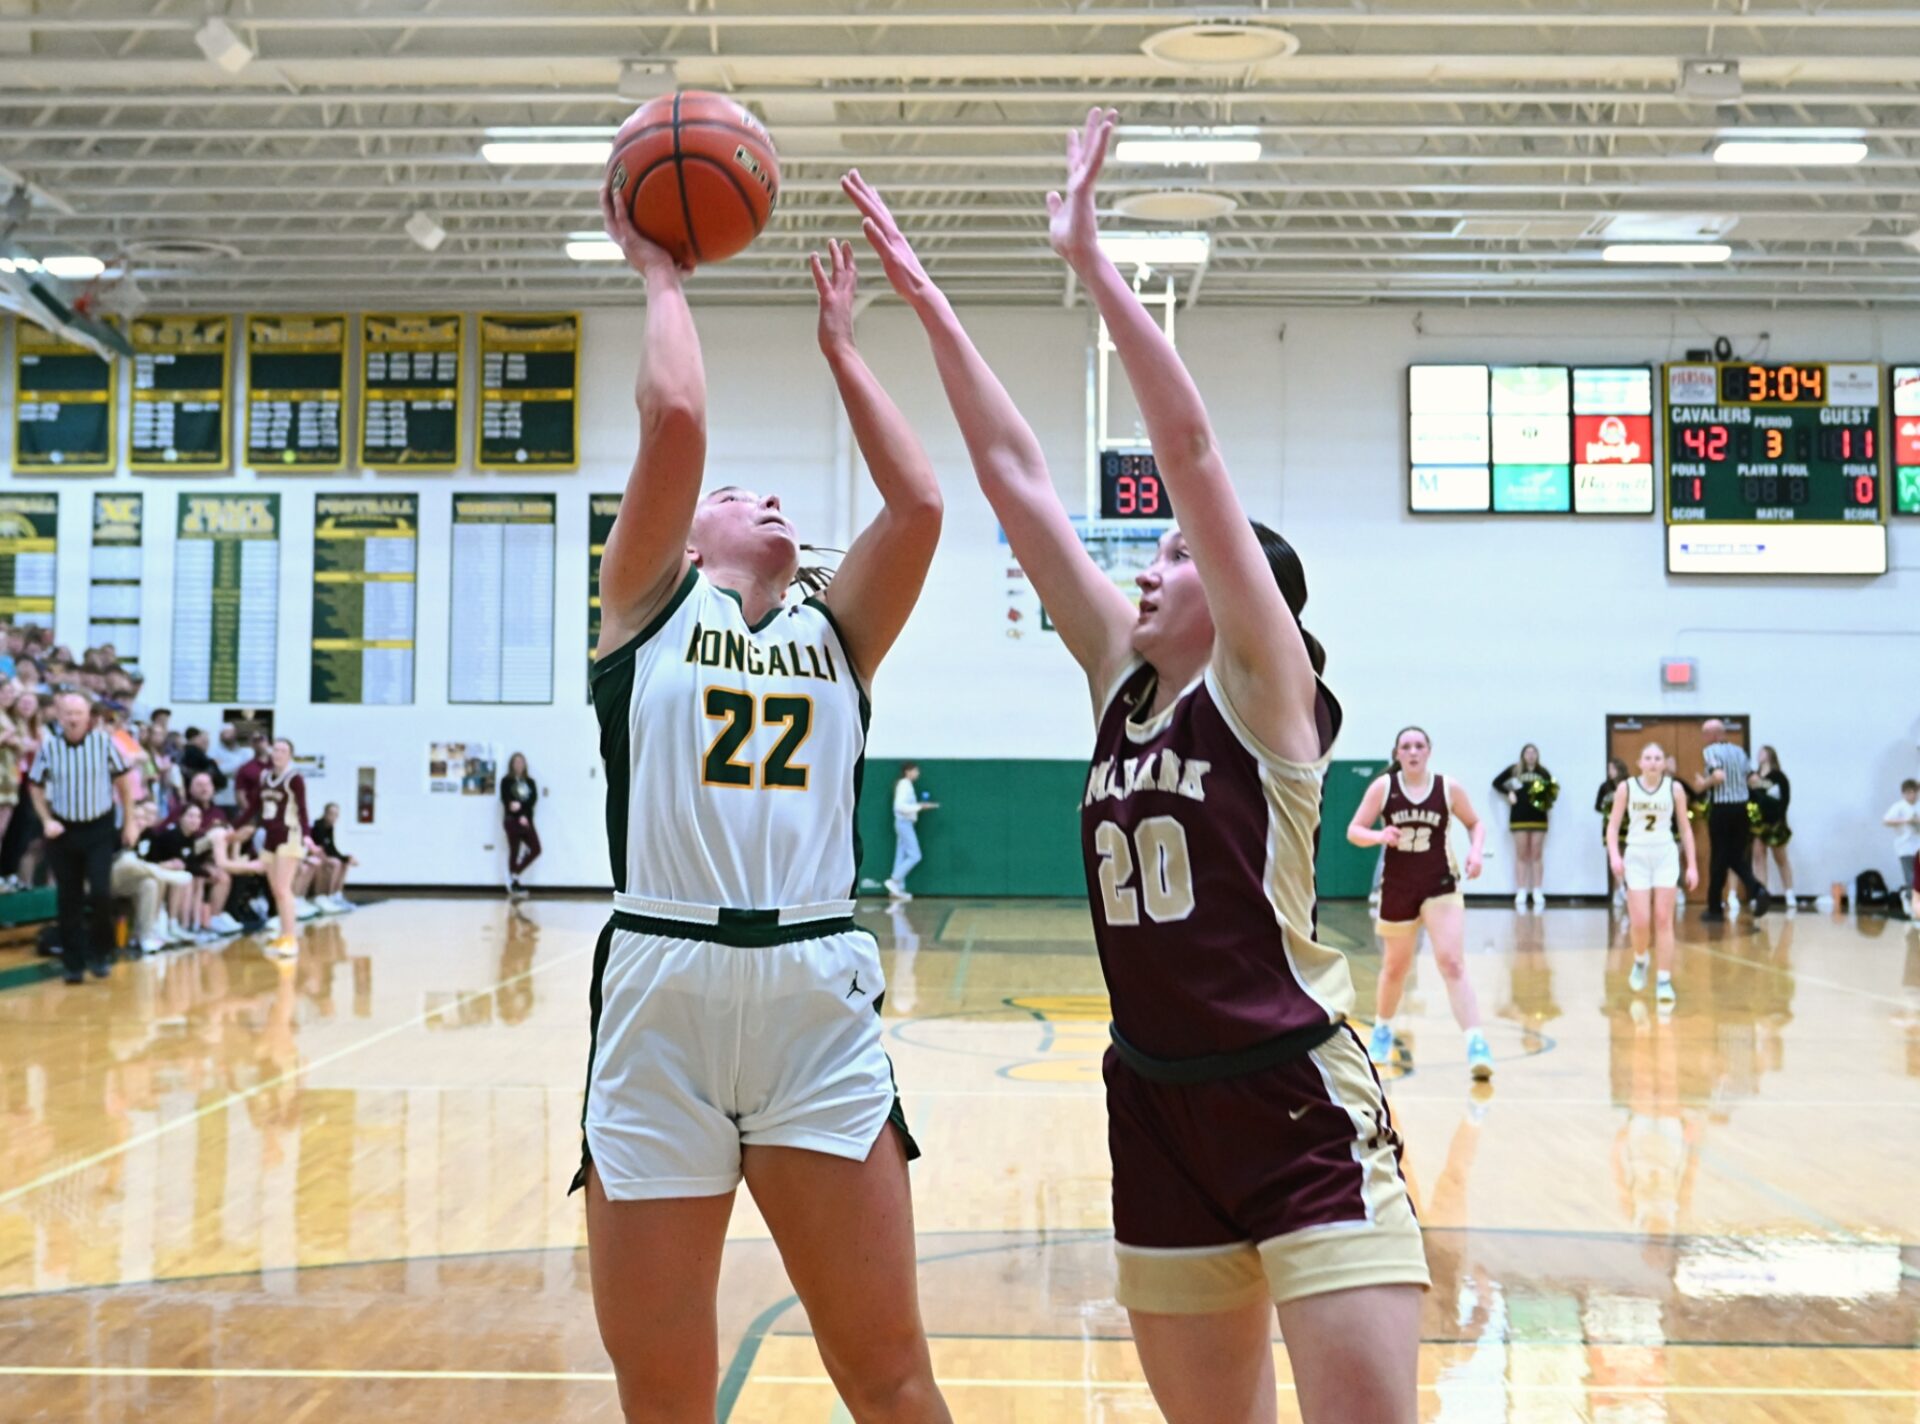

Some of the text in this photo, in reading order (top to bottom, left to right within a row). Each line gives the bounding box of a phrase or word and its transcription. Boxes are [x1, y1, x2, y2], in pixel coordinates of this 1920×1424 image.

[1748, 365, 1822, 402] 3:04
[1671, 407, 1751, 424] CAVALIERS
[1754, 415, 1792, 428] PERIOD
[1820, 407, 1872, 425] GUEST
[1683, 425, 1729, 461] 42
[1766, 429, 1783, 459] 3
[1841, 428, 1874, 459] 11
[1671, 464, 1706, 476] FOULS
[1737, 464, 1810, 476] PLAYER FOUL
[1842, 464, 1878, 476] FOULS
[1116, 476, 1159, 514] 33
[1692, 477, 1702, 501] 1
[1855, 475, 1874, 504] 0
[1672, 508, 1706, 520] SCORE
[1756, 508, 1795, 520] MATCH
[1843, 508, 1878, 520] SCORE
[701, 684, 814, 792] 22
[1095, 815, 1196, 927] 20
